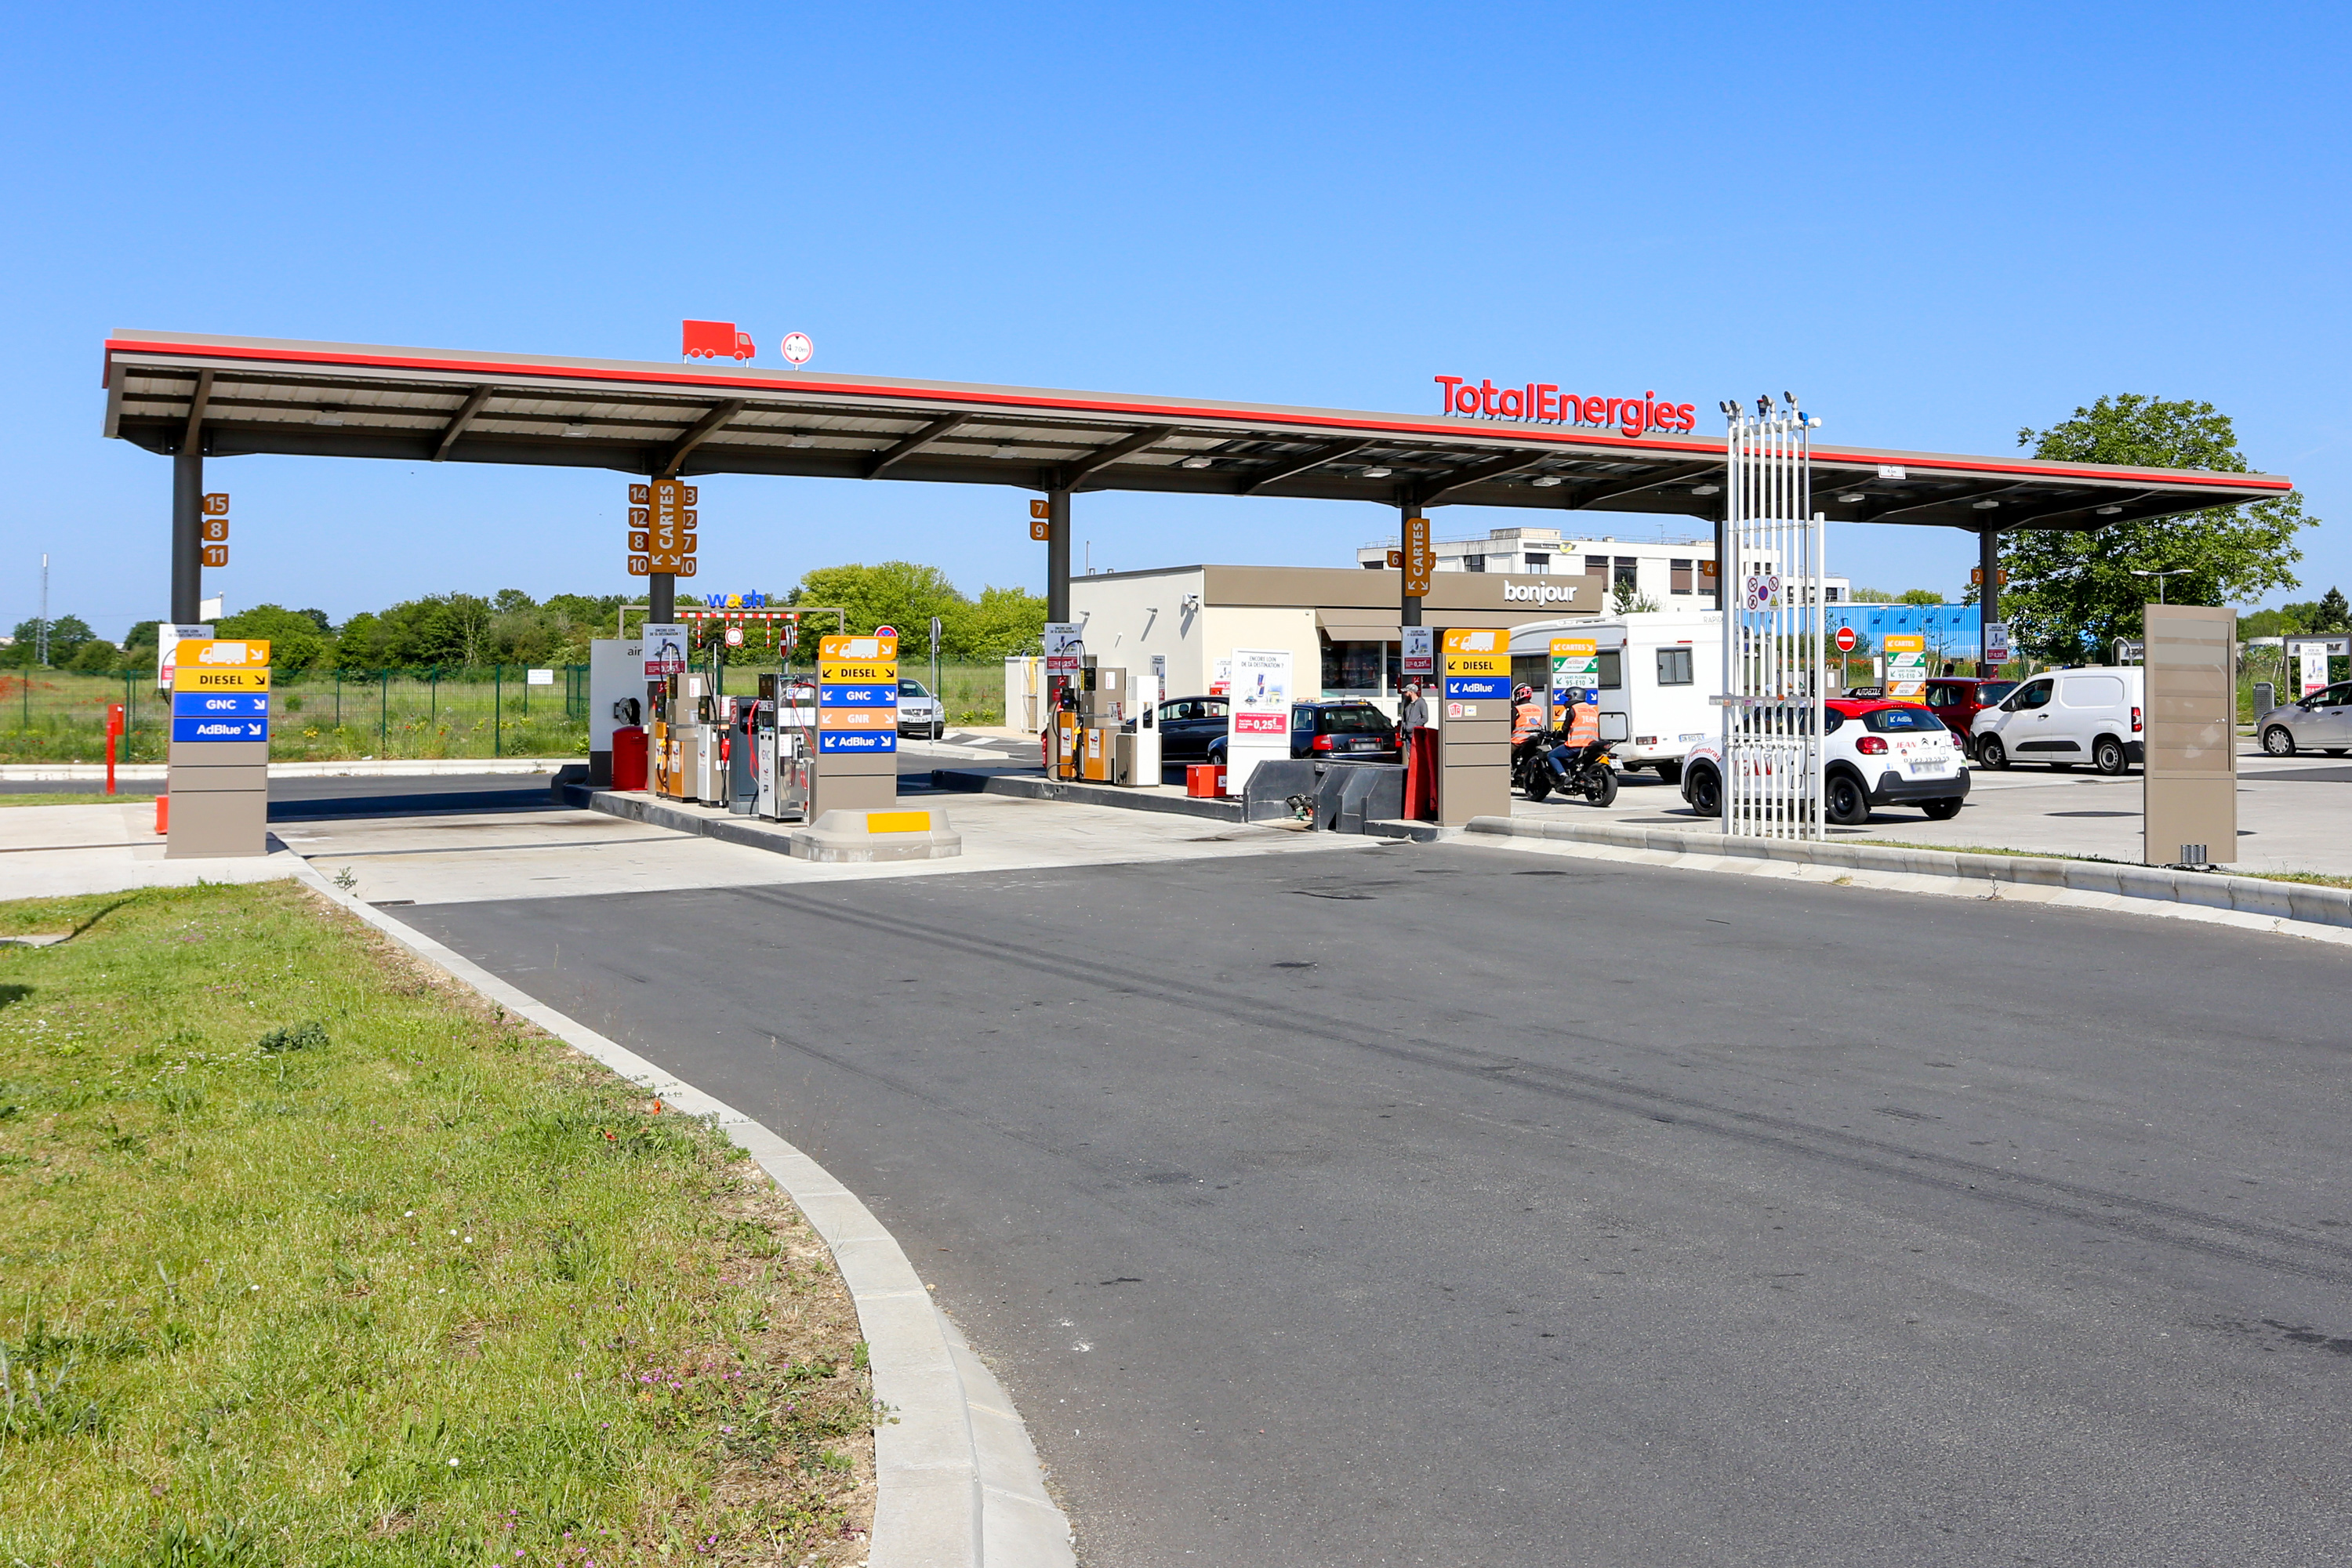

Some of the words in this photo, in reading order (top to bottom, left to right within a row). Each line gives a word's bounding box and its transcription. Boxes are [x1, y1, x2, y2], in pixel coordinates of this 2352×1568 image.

[1434, 375, 1696, 437] TotalEnergies
[630, 487, 648, 501] 14
[206, 496, 227, 512] 15
[1036, 503, 1044, 515] 7
[630, 510, 648, 524] 12
[659, 485, 674, 550] CARTES
[210, 522, 223, 538] 8
[1035, 524, 1044, 538] 9
[633, 535, 644, 548] 8
[683, 536, 691, 550] 7
[208, 548, 225, 563] 11
[1412, 522, 1424, 577] CARTES
[630, 558, 648, 572] 10
[1392, 554, 1399, 565] 6
[1707, 563, 1714, 574] 4
[1975, 571, 1980, 582] 2
[1999, 572, 2003, 582] 1
[706, 589, 765, 608] wash
[1504, 579, 1578, 608] bonjour
[627, 646, 642, 656] air
[841, 669, 877, 677] DIESEL
[200, 676, 244, 684] DIESEL
[1462, 683, 1493, 693] AdBlue
[846, 691, 871, 701] GNC
[205, 699, 237, 710] GNC
[847, 714, 869, 724] GNR
[1253, 717, 1277, 731] 0,25€
[1581, 715, 1598, 724] JEAN
[196, 724, 241, 735] AdBlue
[839, 737, 875, 746] AdBlue
